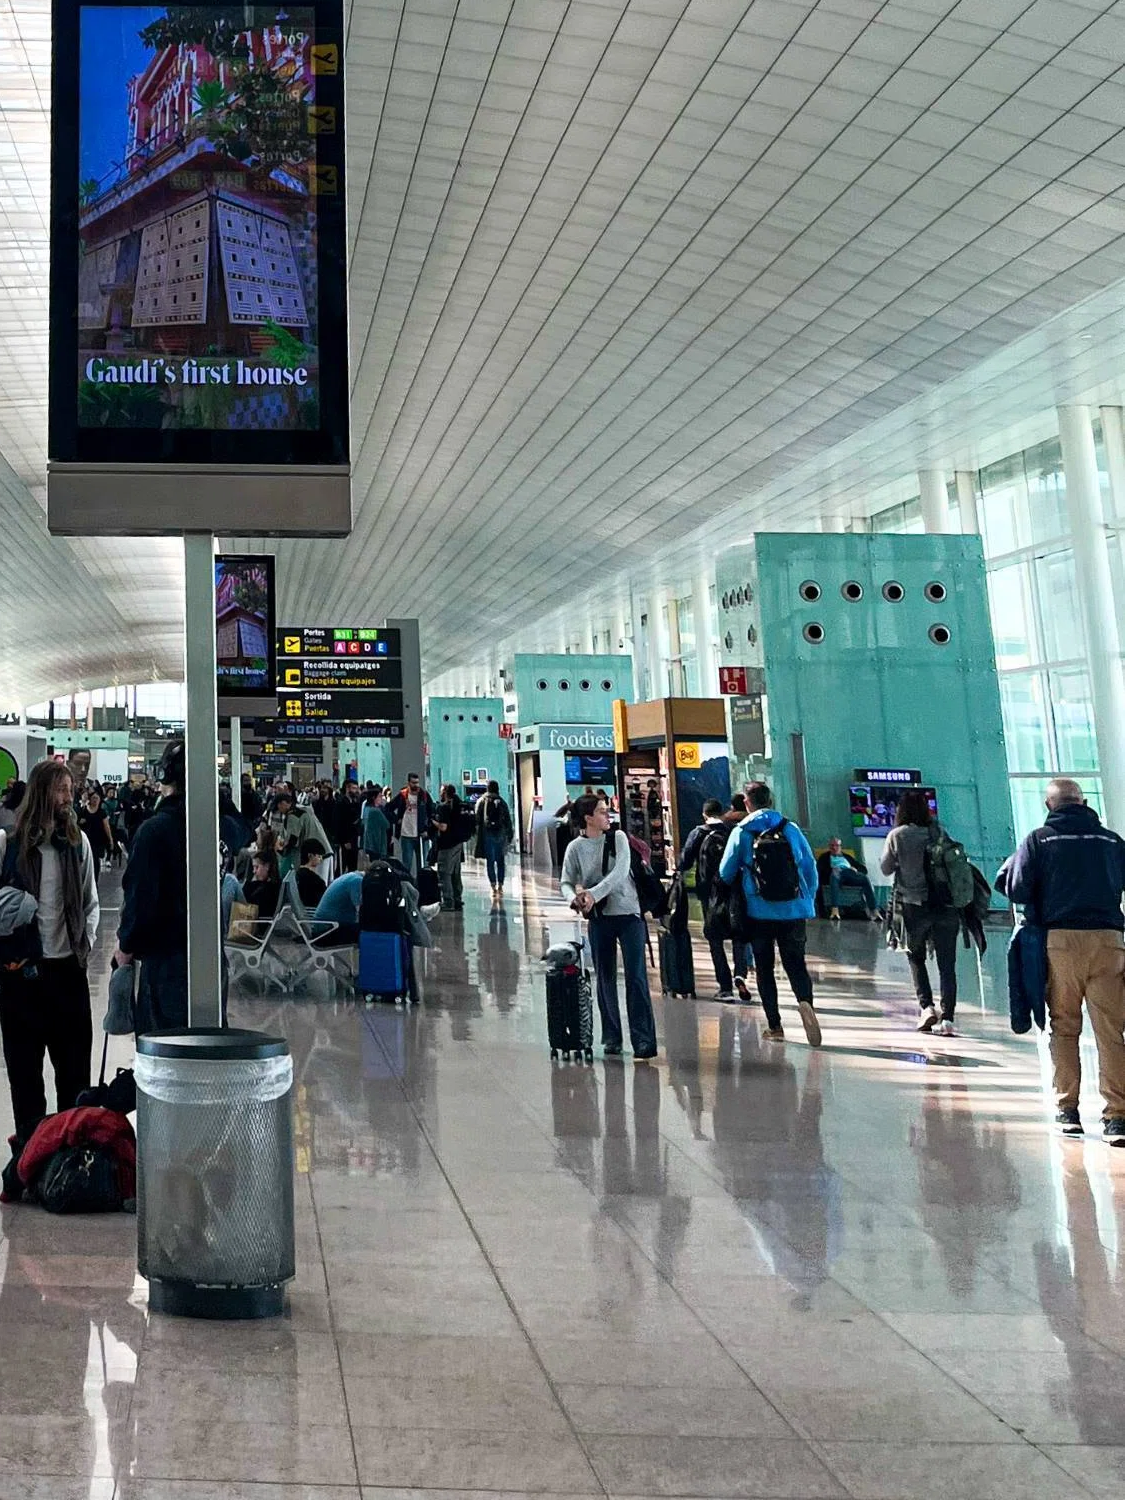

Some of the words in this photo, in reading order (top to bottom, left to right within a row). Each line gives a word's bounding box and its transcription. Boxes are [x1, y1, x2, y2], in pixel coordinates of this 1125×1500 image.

[181, 358, 231, 385] first
[236, 360, 308, 385] house
[304, 644, 330, 652] Puertas
[336, 642, 344, 652] A
[350, 642, 358, 652] C
[364, 642, 371, 652] D
[377, 642, 384, 652] E
[303, 661, 338, 669] Recollida
[339, 661, 381, 671] equipatges
[303, 669, 330, 678] Baggage
[304, 677, 339, 686] Recogida
[340, 677, 376, 686] equipajes
[304, 692, 332, 700] Sortida
[305, 707, 328, 716] Salida
[335, 725, 353, 736] Sky
[355, 725, 387, 735] Centre
[549, 729, 613, 748] foodies
[867, 771, 911, 781] SAMSUNG
